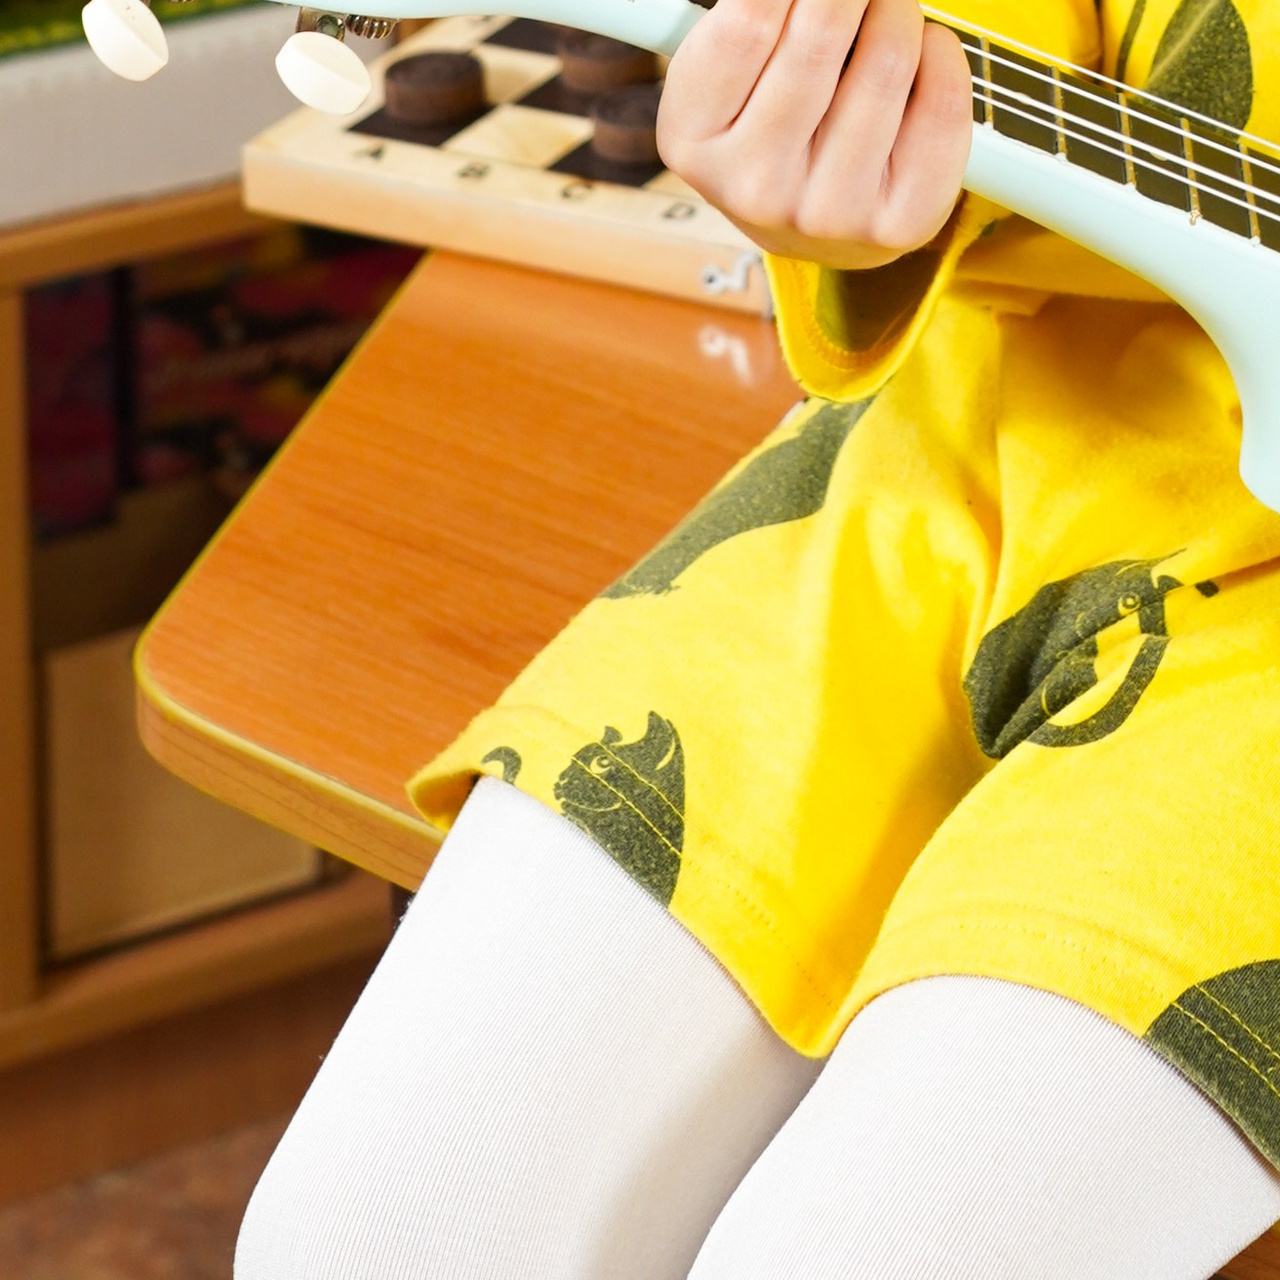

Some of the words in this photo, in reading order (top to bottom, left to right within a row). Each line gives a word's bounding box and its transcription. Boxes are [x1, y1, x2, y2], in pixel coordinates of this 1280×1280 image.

[354, 144, 385, 162] A
[457, 163, 490, 181] B
[661, 201, 697, 221] D
